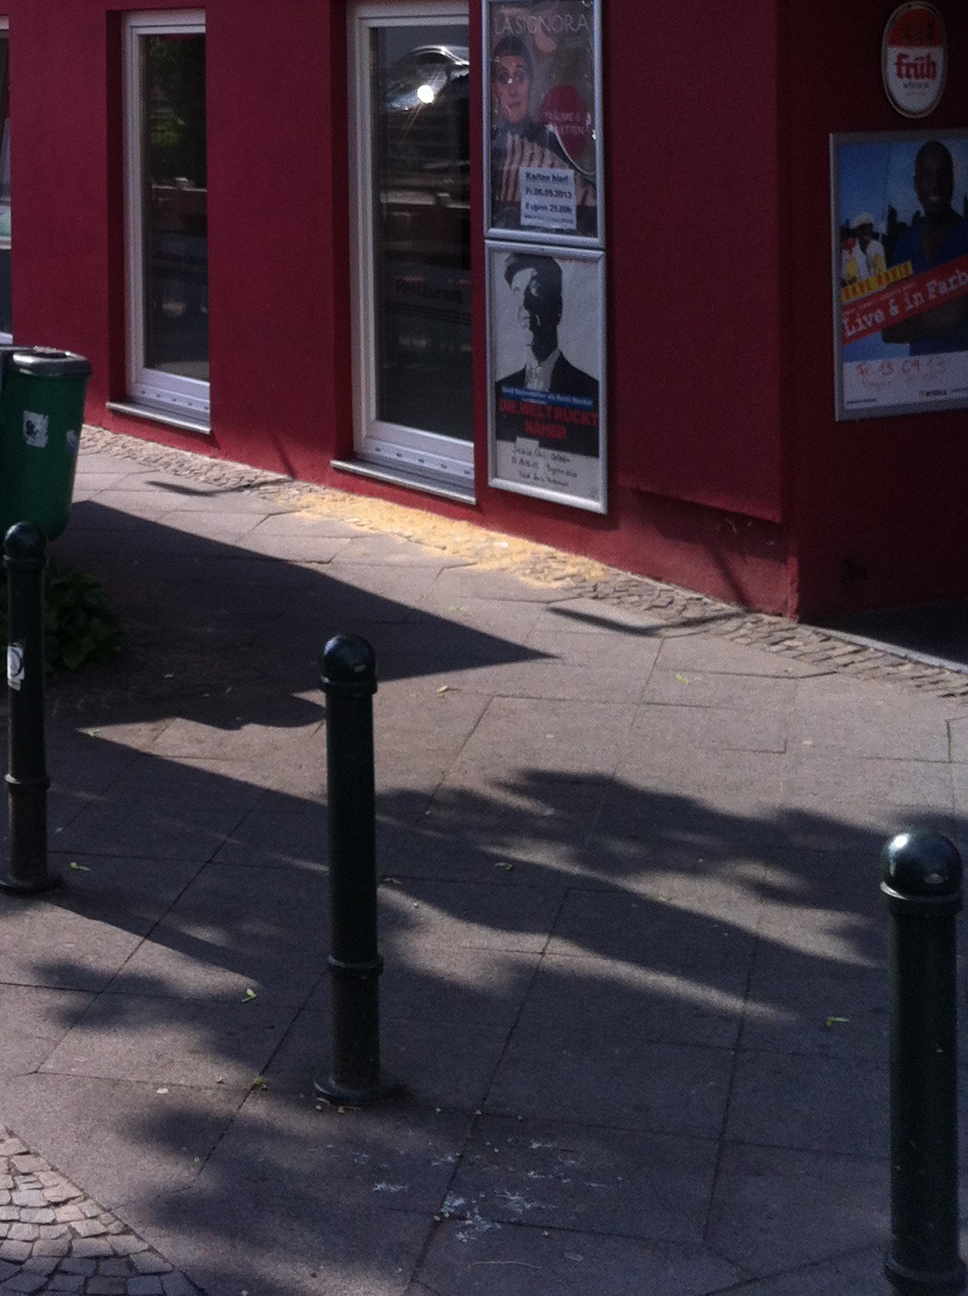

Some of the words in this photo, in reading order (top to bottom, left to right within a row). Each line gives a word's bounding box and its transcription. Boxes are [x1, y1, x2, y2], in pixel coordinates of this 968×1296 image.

[895, 52, 937, 81] früh
[842, 309, 885, 338] Live
[903, 290, 925, 311] in
